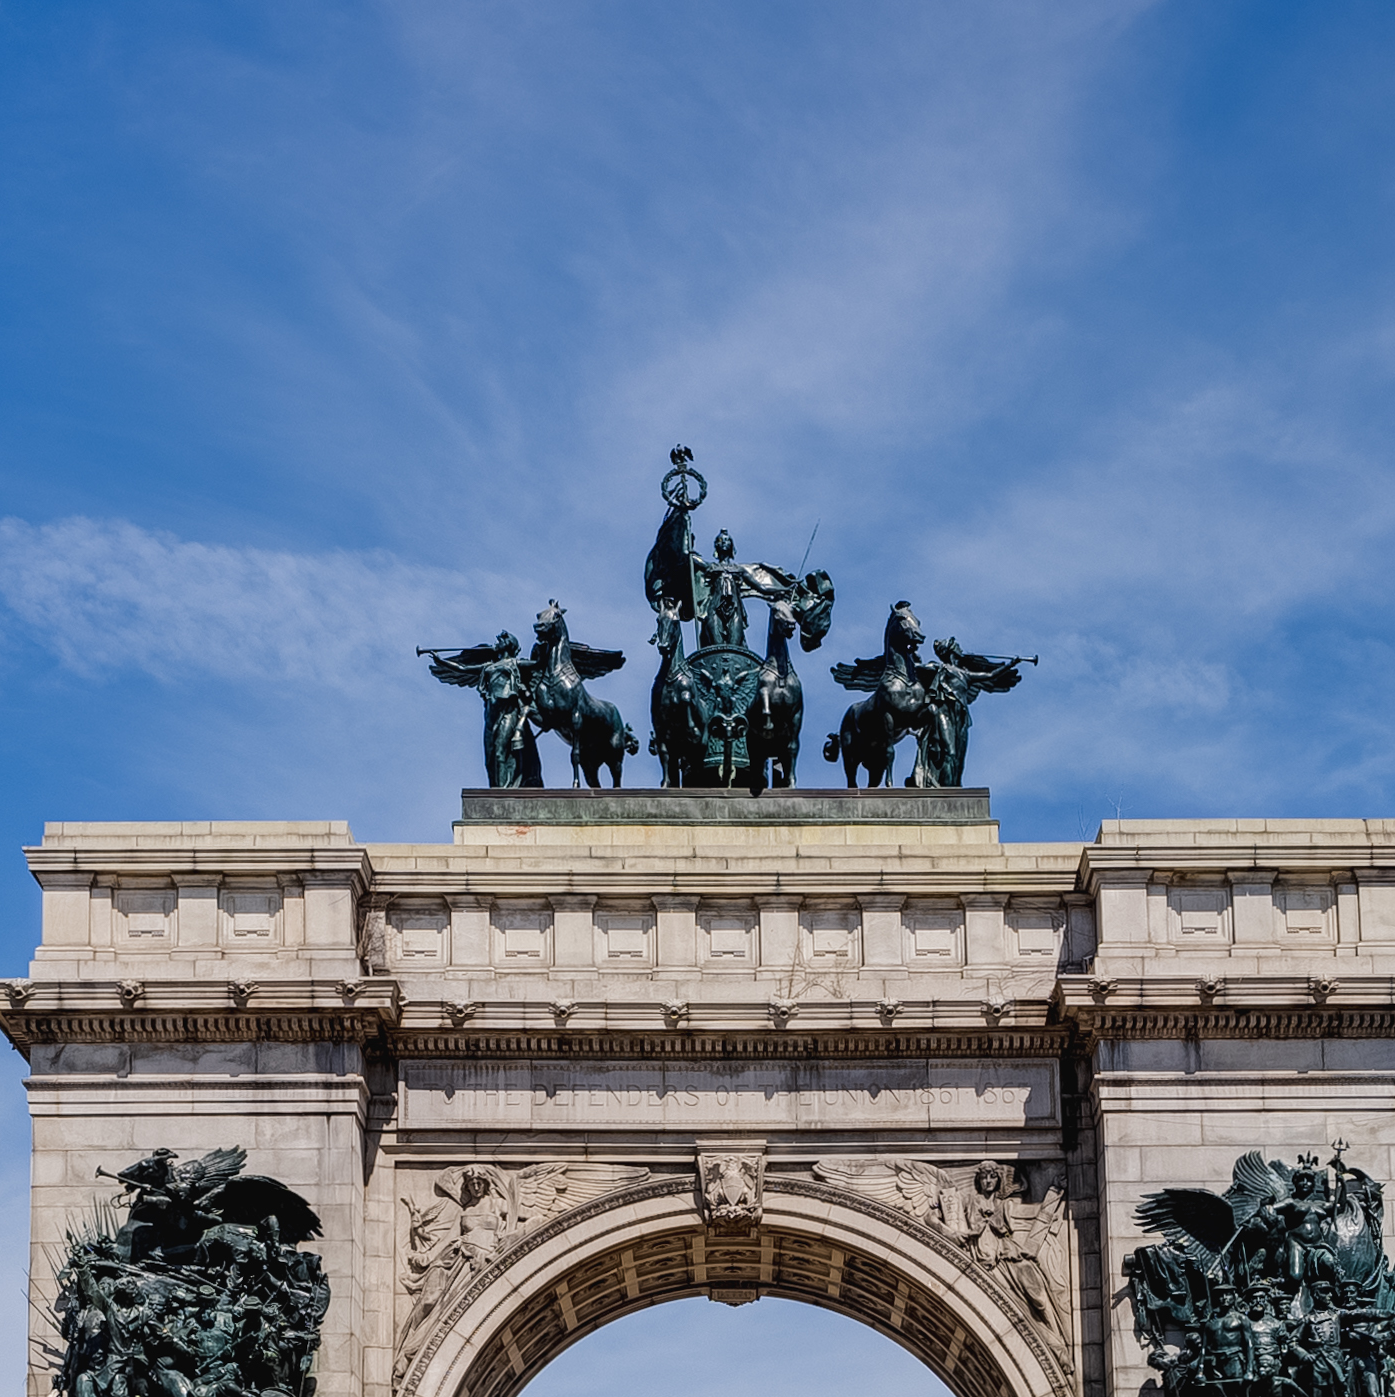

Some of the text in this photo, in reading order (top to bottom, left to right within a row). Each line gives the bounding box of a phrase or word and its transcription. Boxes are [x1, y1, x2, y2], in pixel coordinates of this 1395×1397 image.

[423, 1083, 454, 1105] TO
[465, 1083, 521, 1106] THE
[532, 1083, 700, 1106] DEFENDERS
[716, 1084, 749, 1107] OF
[758, 1084, 813, 1107] THE
[822, 1083, 901, 1106] UNION
